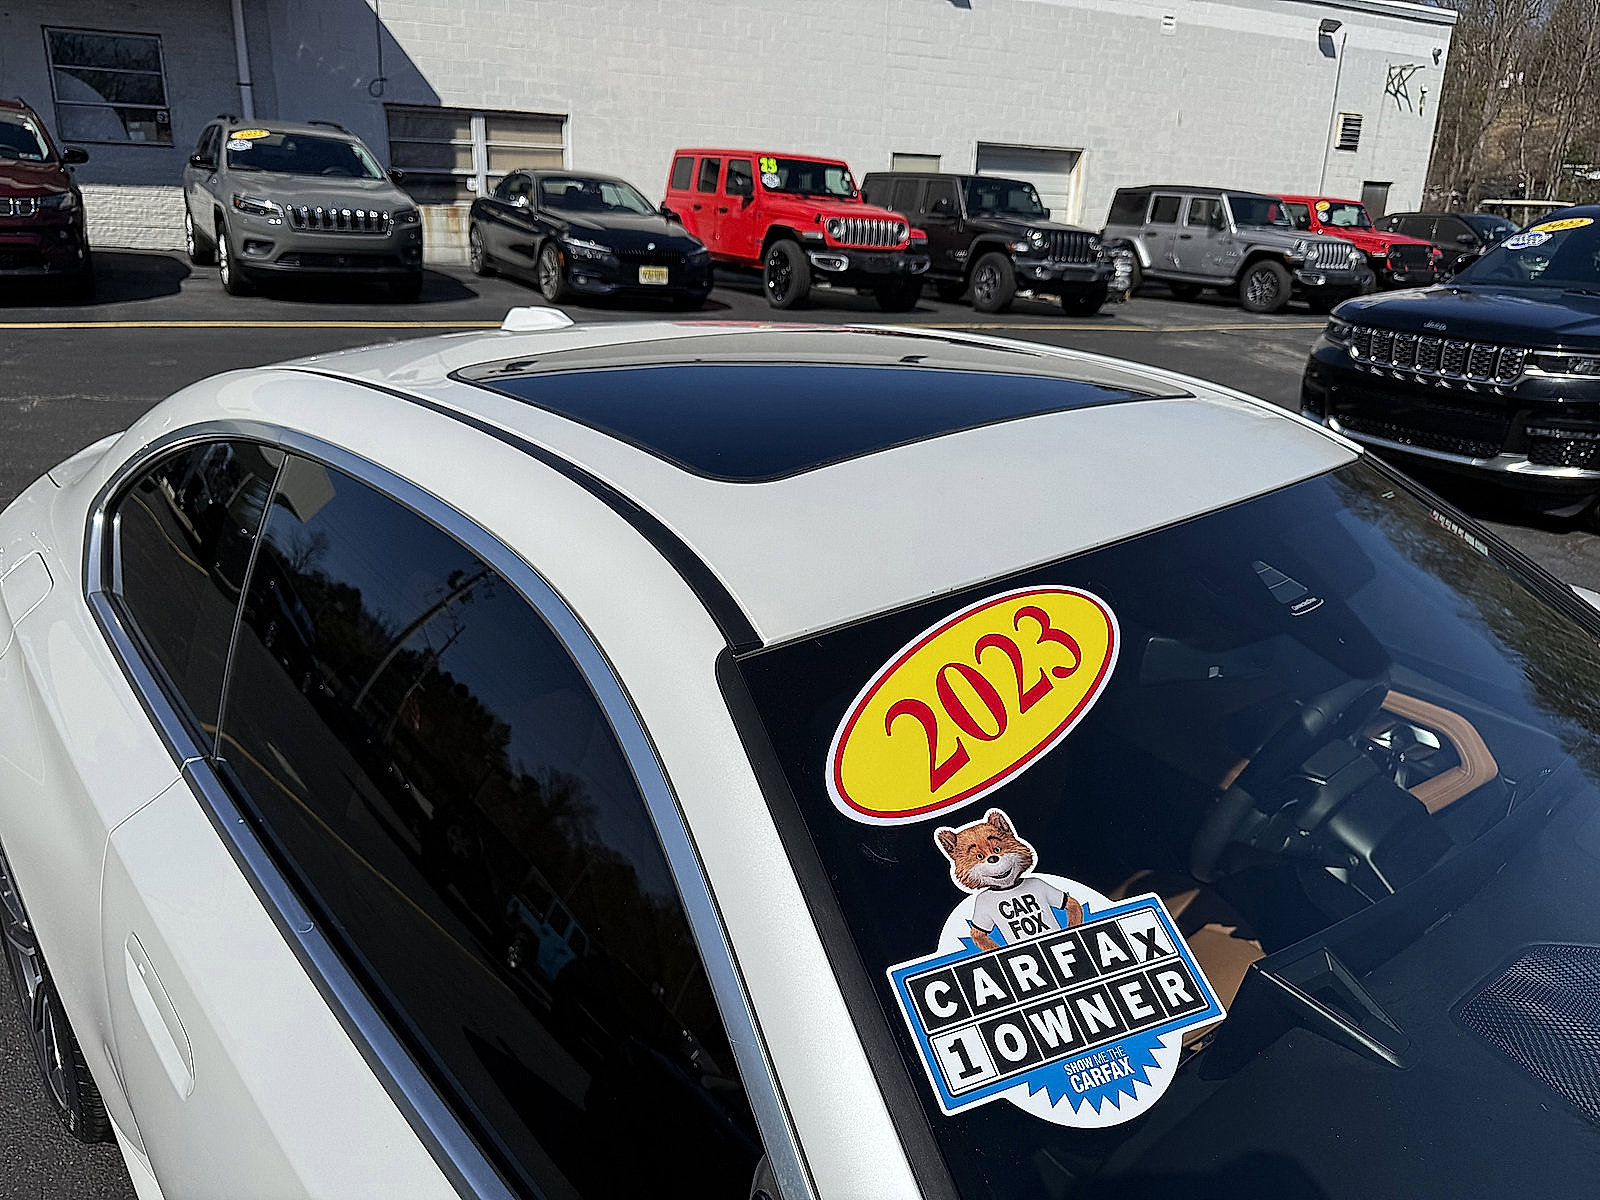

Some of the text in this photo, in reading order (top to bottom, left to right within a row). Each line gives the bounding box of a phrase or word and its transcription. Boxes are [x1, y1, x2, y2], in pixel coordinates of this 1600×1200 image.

[885, 606, 1082, 792] 2023
[998, 894, 1041, 920] CAR
[1007, 911, 1051, 940] FOX
[924, 926, 1170, 1018] CARFAX
[942, 970, 1195, 1080] 1 OWNER
[1063, 1045, 1127, 1076] SHOW ME THE
[1070, 1056, 1136, 1094] CARFAX
